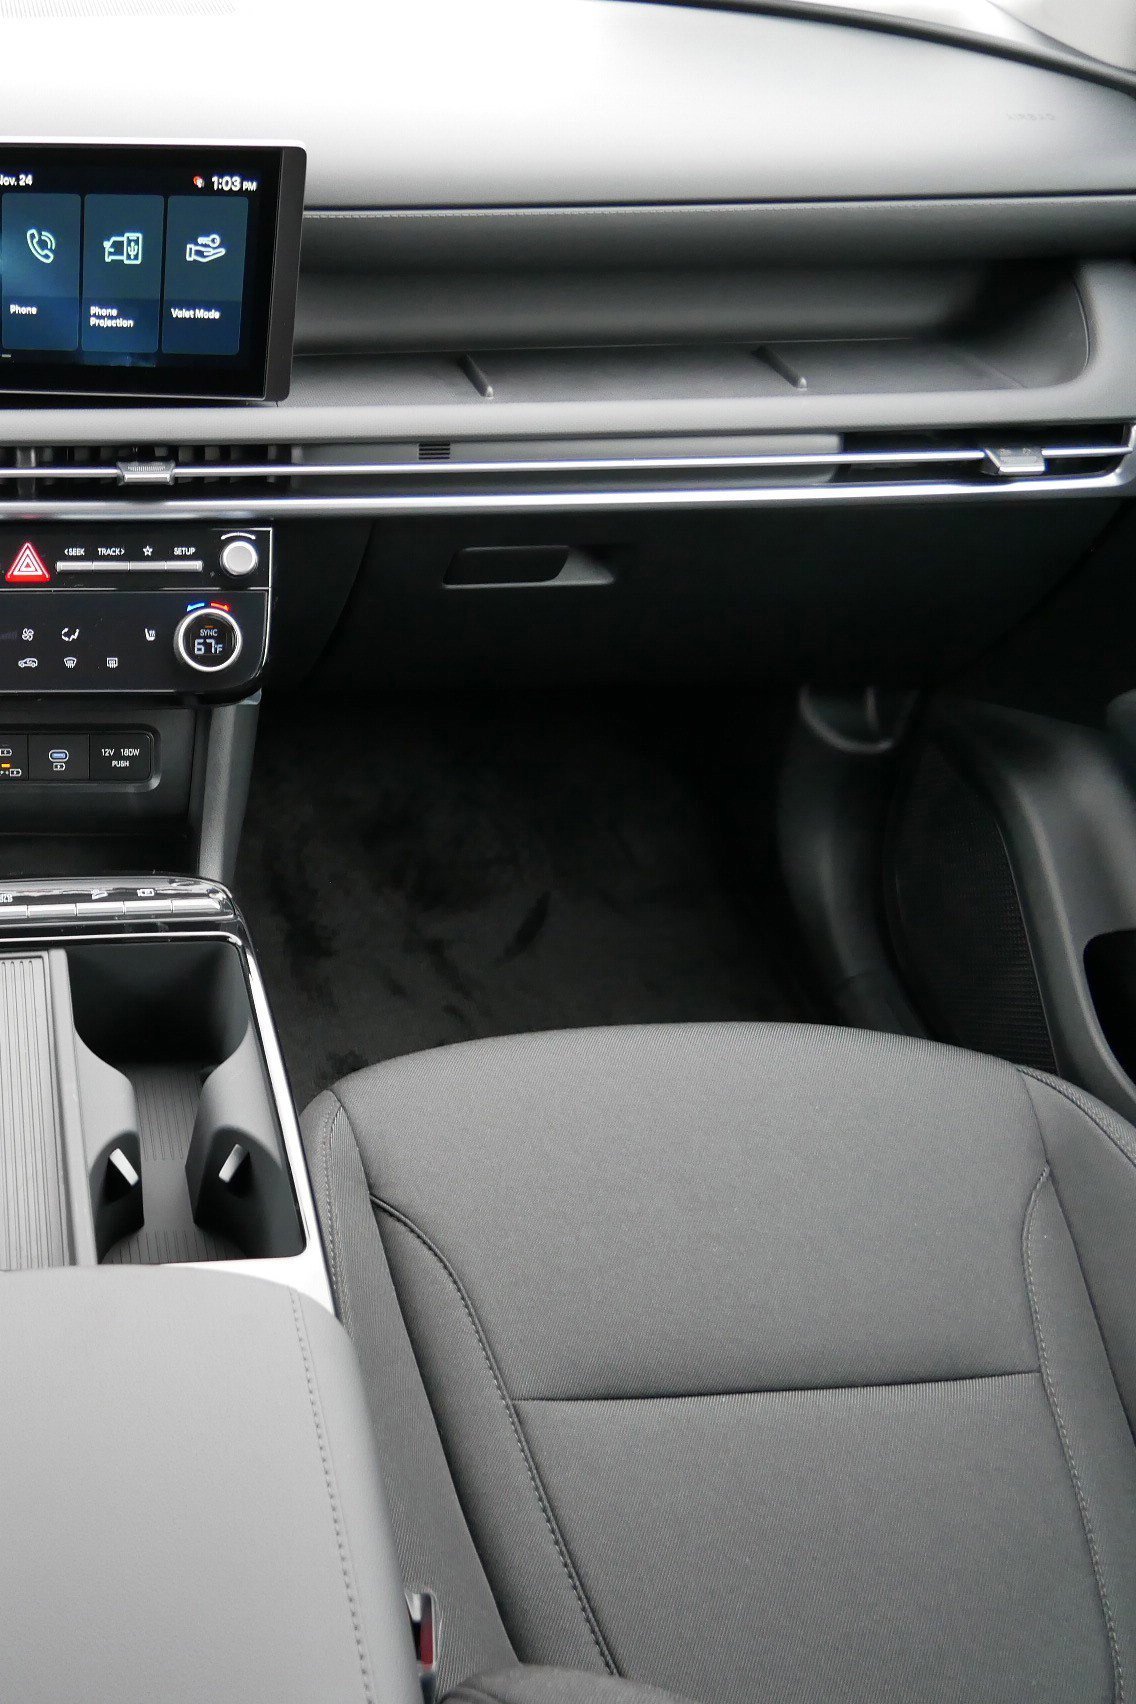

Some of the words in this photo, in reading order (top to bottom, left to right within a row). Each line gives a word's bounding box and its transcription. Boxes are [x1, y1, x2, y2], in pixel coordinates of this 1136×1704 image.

[18, 174, 33, 186] 24
[211, 176, 241, 191] 1:03
[242, 180, 257, 191] PM
[9, 304, 37, 316] Phone
[90, 306, 118, 317] Phone
[171, 308, 195, 319] Valet
[195, 309, 220, 320] Mode
[89, 316, 134, 329] Projection
[173, 547, 196, 556] SETUP
[199, 628, 218, 637] SYNC
[101, 748, 115, 757] 12V
[111, 760, 130, 768] PUSH
